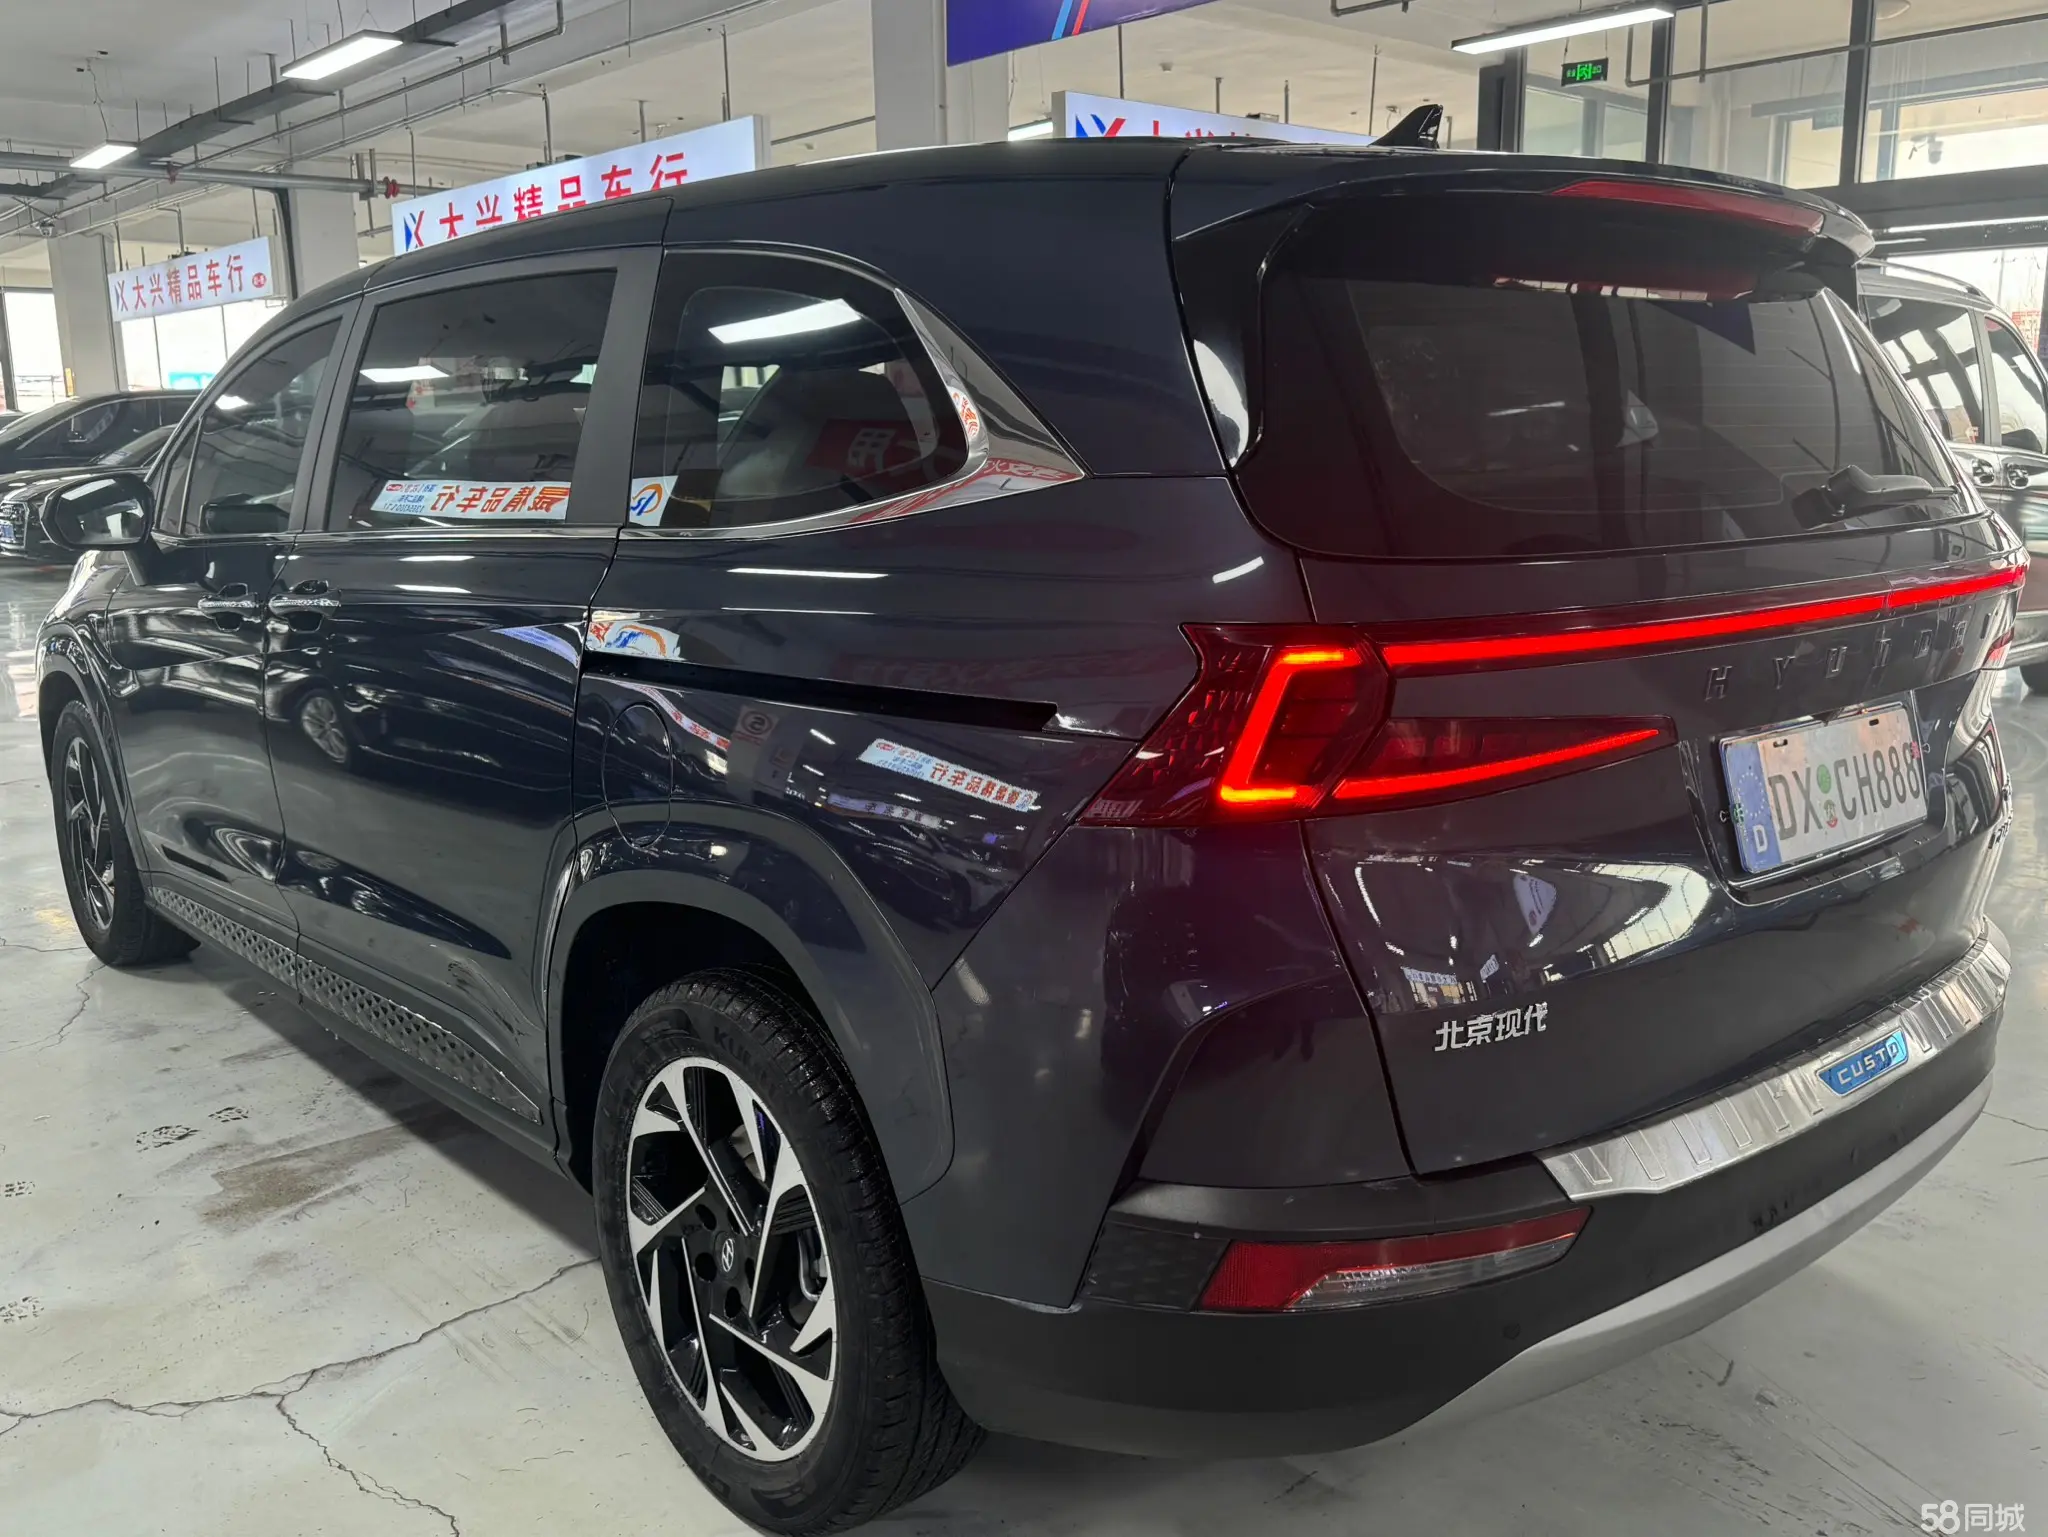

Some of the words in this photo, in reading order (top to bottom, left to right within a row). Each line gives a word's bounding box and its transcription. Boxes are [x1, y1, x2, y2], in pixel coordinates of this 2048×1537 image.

[132, 254, 244, 311] 大兴精品车行
[1704, 612, 1991, 701] HYUNDAI
[1768, 766, 1823, 841] DX
[1833, 741, 1921, 820] CH888
[1753, 824, 1768, 853] D
[1434, 1001, 1549, 1052] 北京现代
[1836, 1040, 1900, 1085] CUSTO
